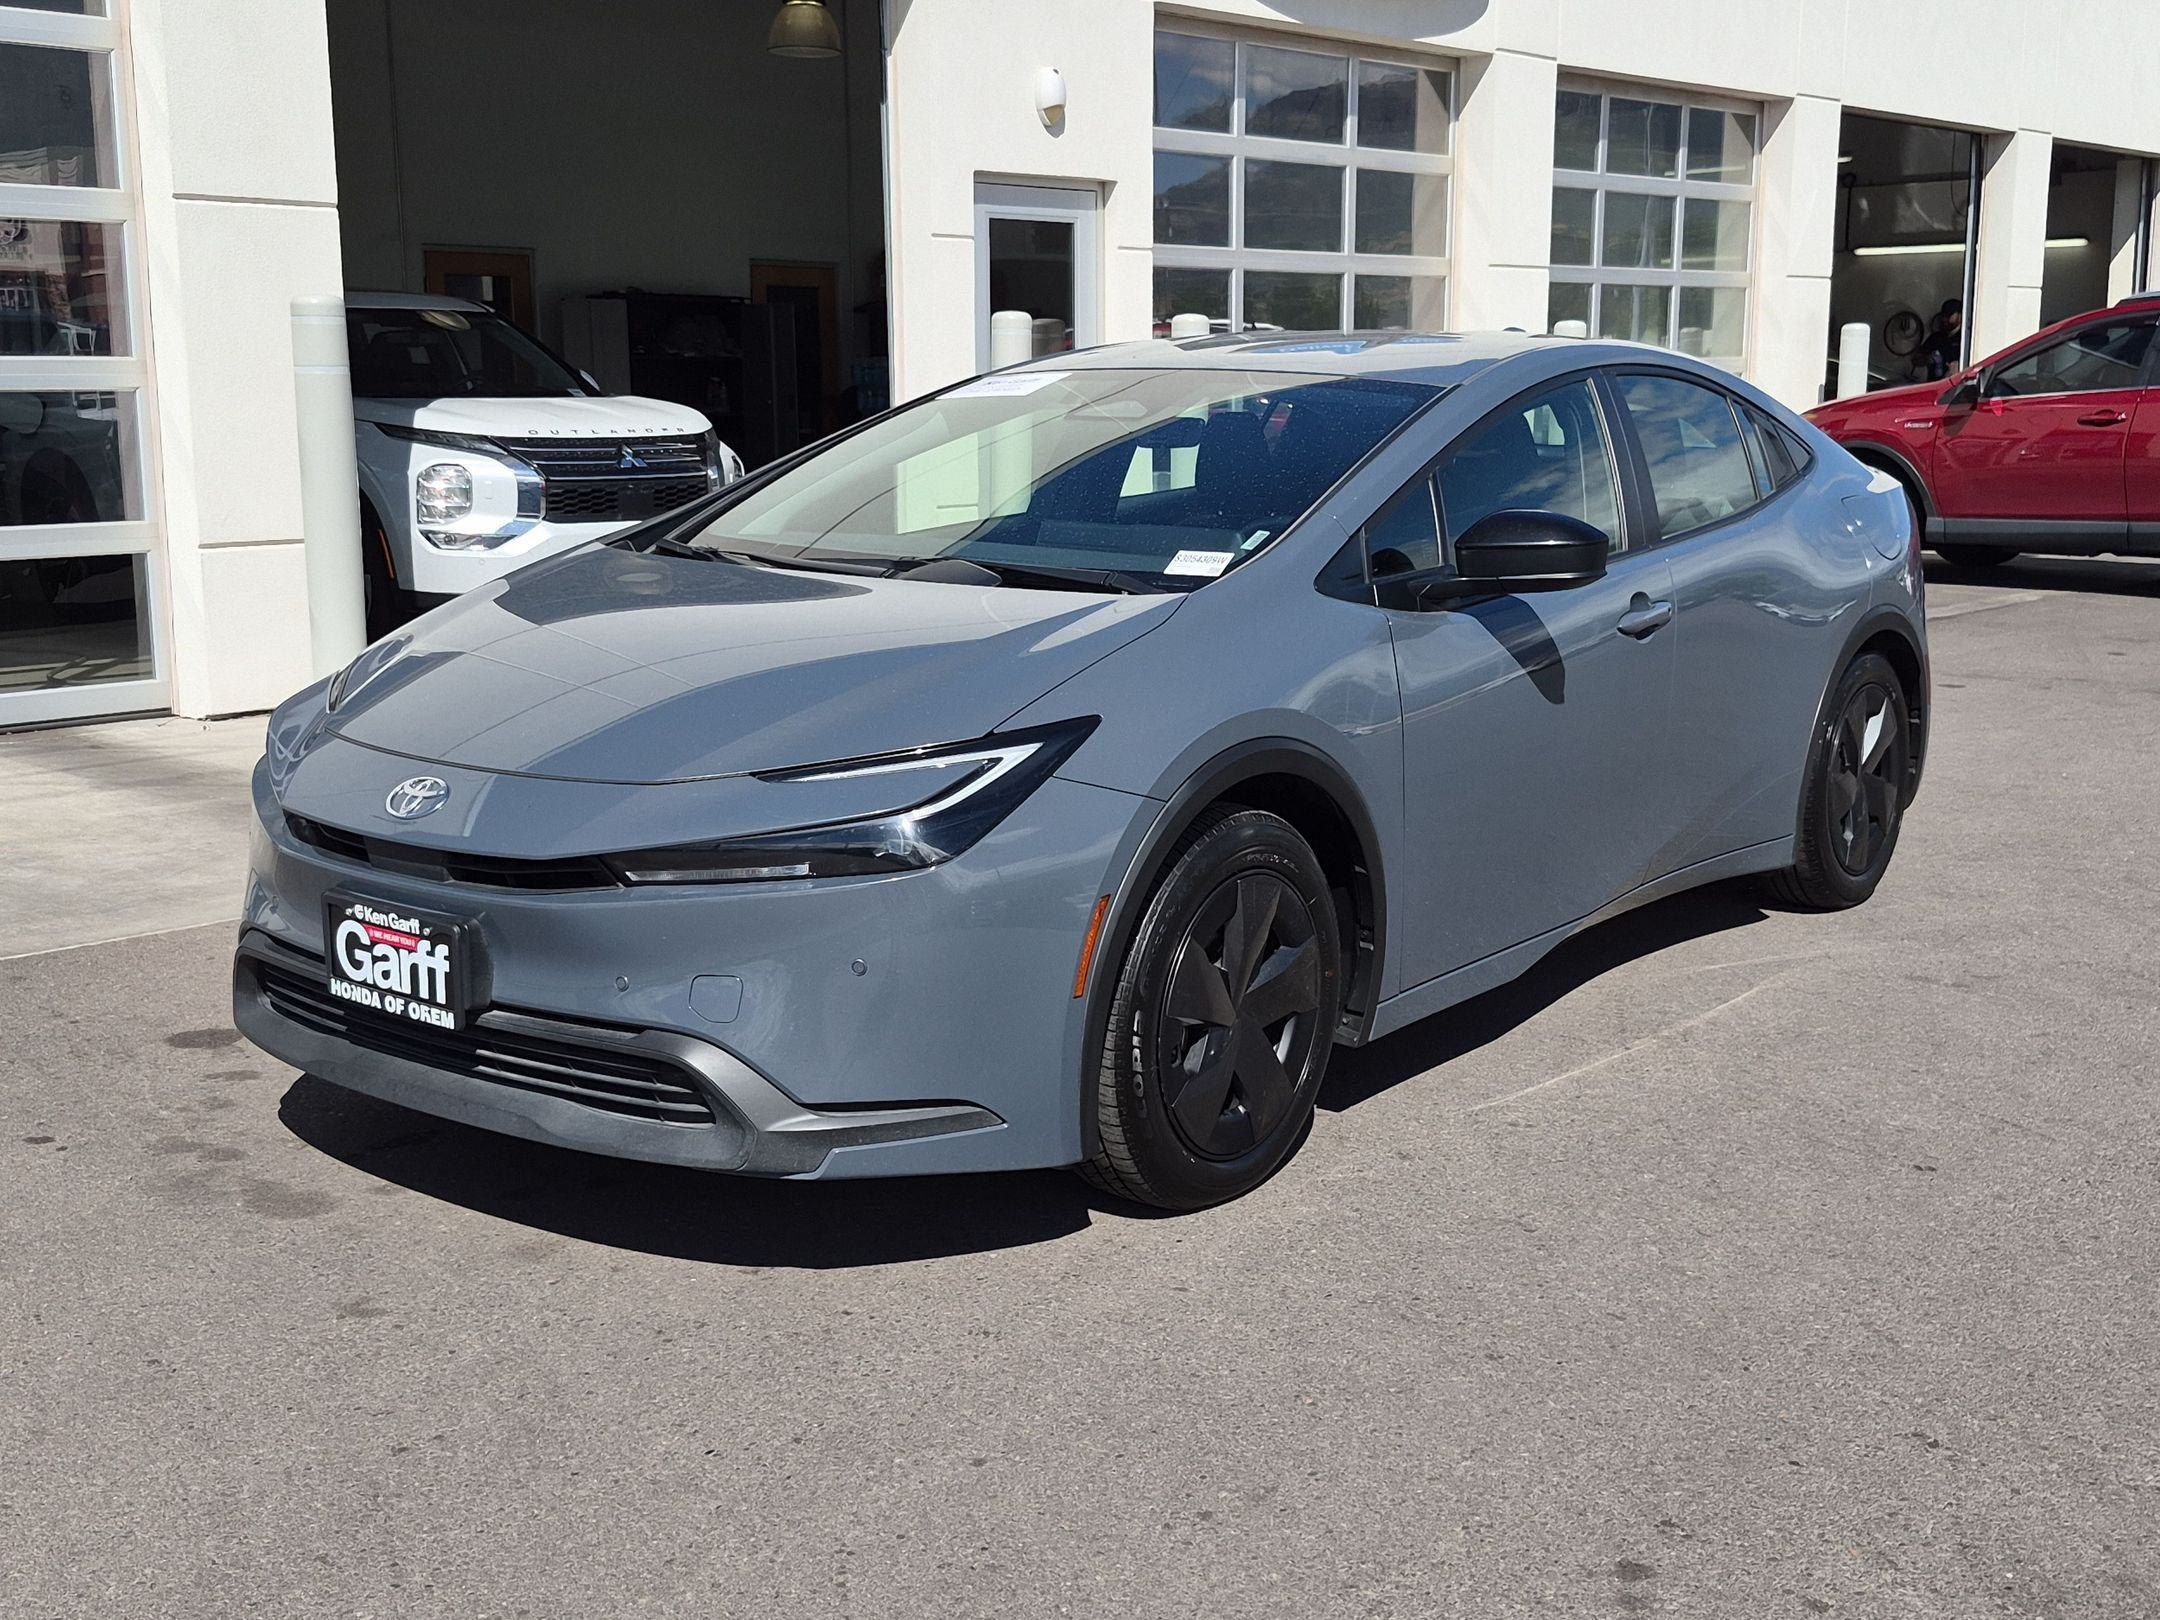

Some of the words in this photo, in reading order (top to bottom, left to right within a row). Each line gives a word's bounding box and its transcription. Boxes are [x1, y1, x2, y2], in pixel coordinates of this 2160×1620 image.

[528, 427, 685, 435] OUTLANDER
[364, 905, 389, 927] Ken
[389, 912, 421, 935] Garff
[336, 919, 450, 1005] Garff
[330, 978, 382, 1009] HONDA
[384, 995, 405, 1015] OF
[408, 1002, 455, 1030] OREM
[1131, 1009, 1148, 1125] COPIA
